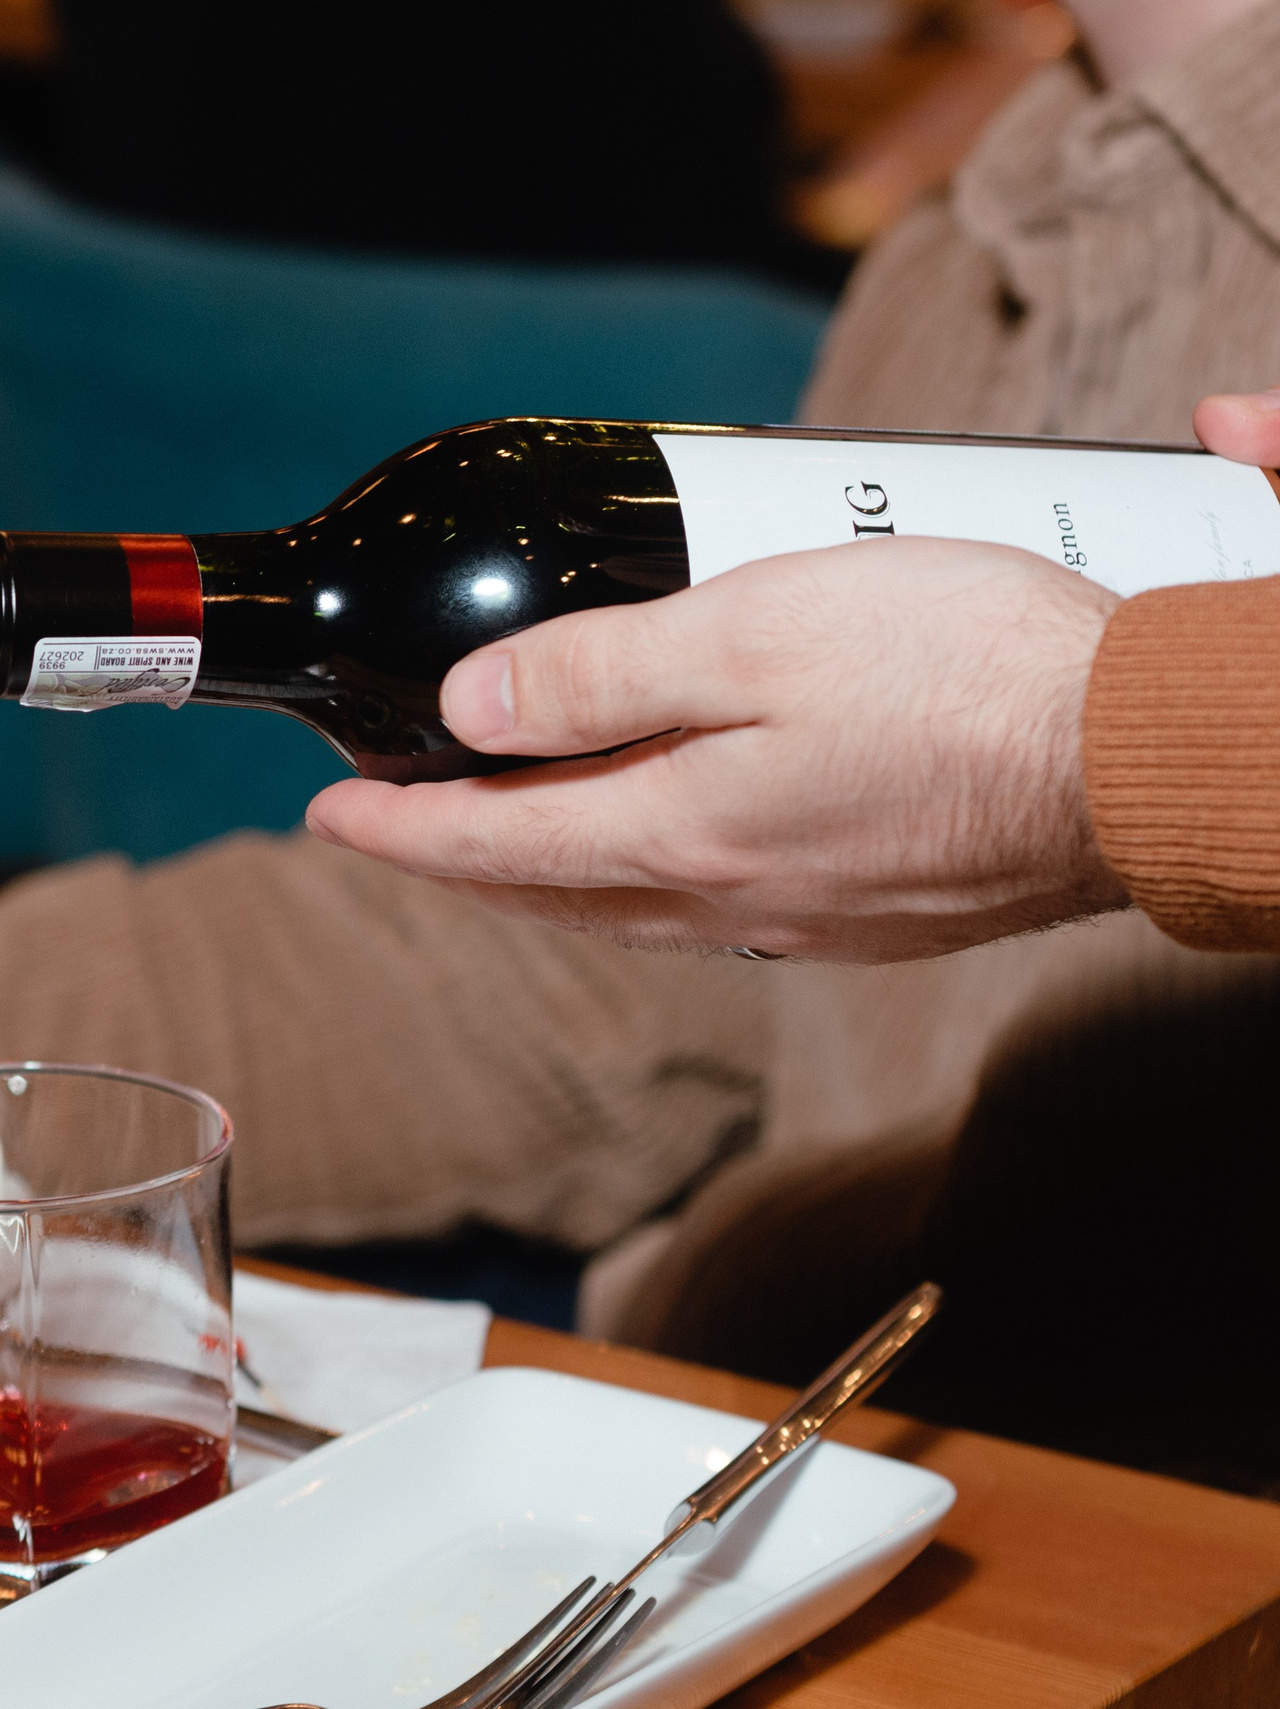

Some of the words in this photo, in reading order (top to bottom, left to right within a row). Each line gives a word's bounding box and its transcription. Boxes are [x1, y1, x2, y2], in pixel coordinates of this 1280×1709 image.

[844, 480, 895, 538] IG
[102, 647, 195, 655] www.swsa.co.za
[40, 651, 85, 662] 202627
[100, 656, 126, 666] BOARD
[128, 656, 153, 666] SPIRIT
[155, 656, 172, 666] AND
[173, 656, 194, 666] WINE
[39, 661, 66, 670] 9939
[79, 668, 191, 697] Certified
